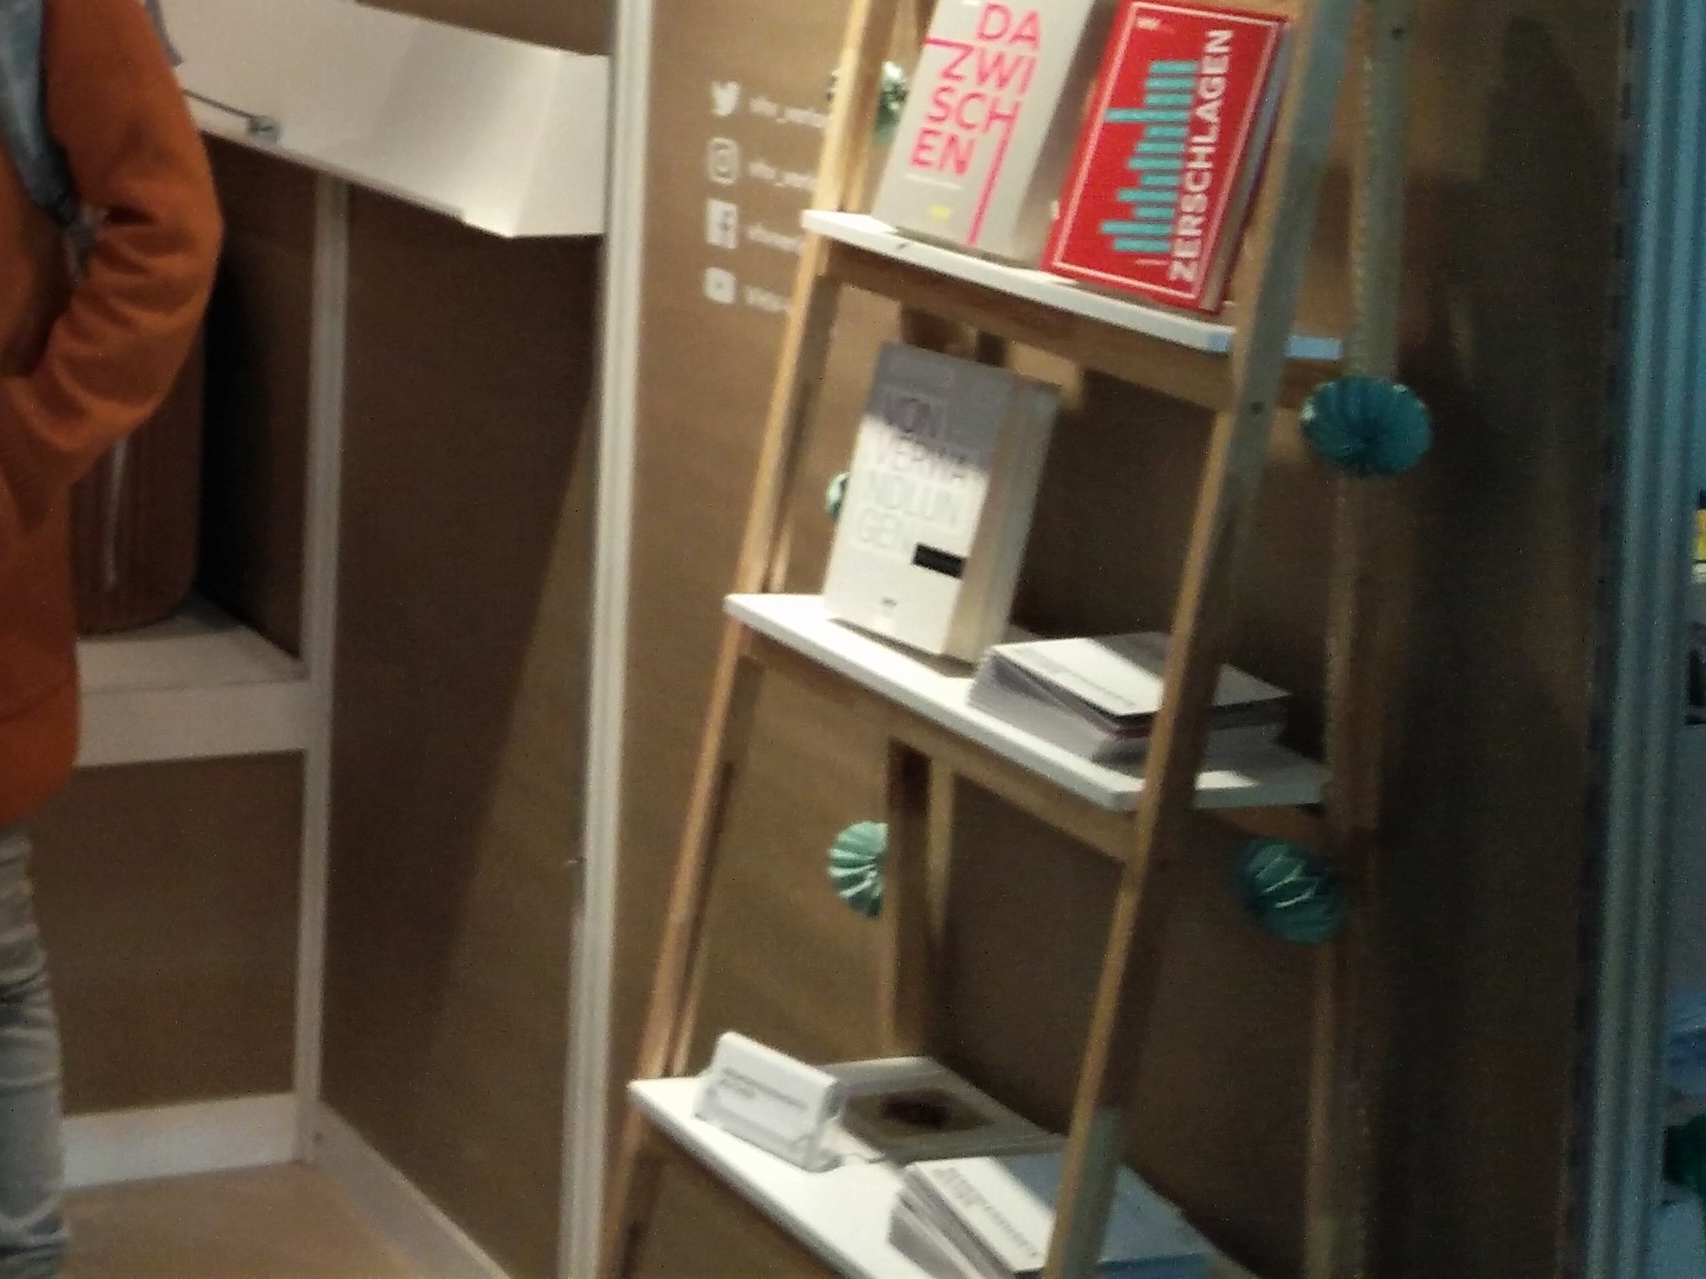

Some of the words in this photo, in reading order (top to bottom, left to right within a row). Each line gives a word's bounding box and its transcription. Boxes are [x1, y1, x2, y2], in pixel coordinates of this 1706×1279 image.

[976, 2, 1043, 49] DA
[908, 125, 976, 178] EN
[1168, 29, 1234, 282] ZERSCHLAGEN
